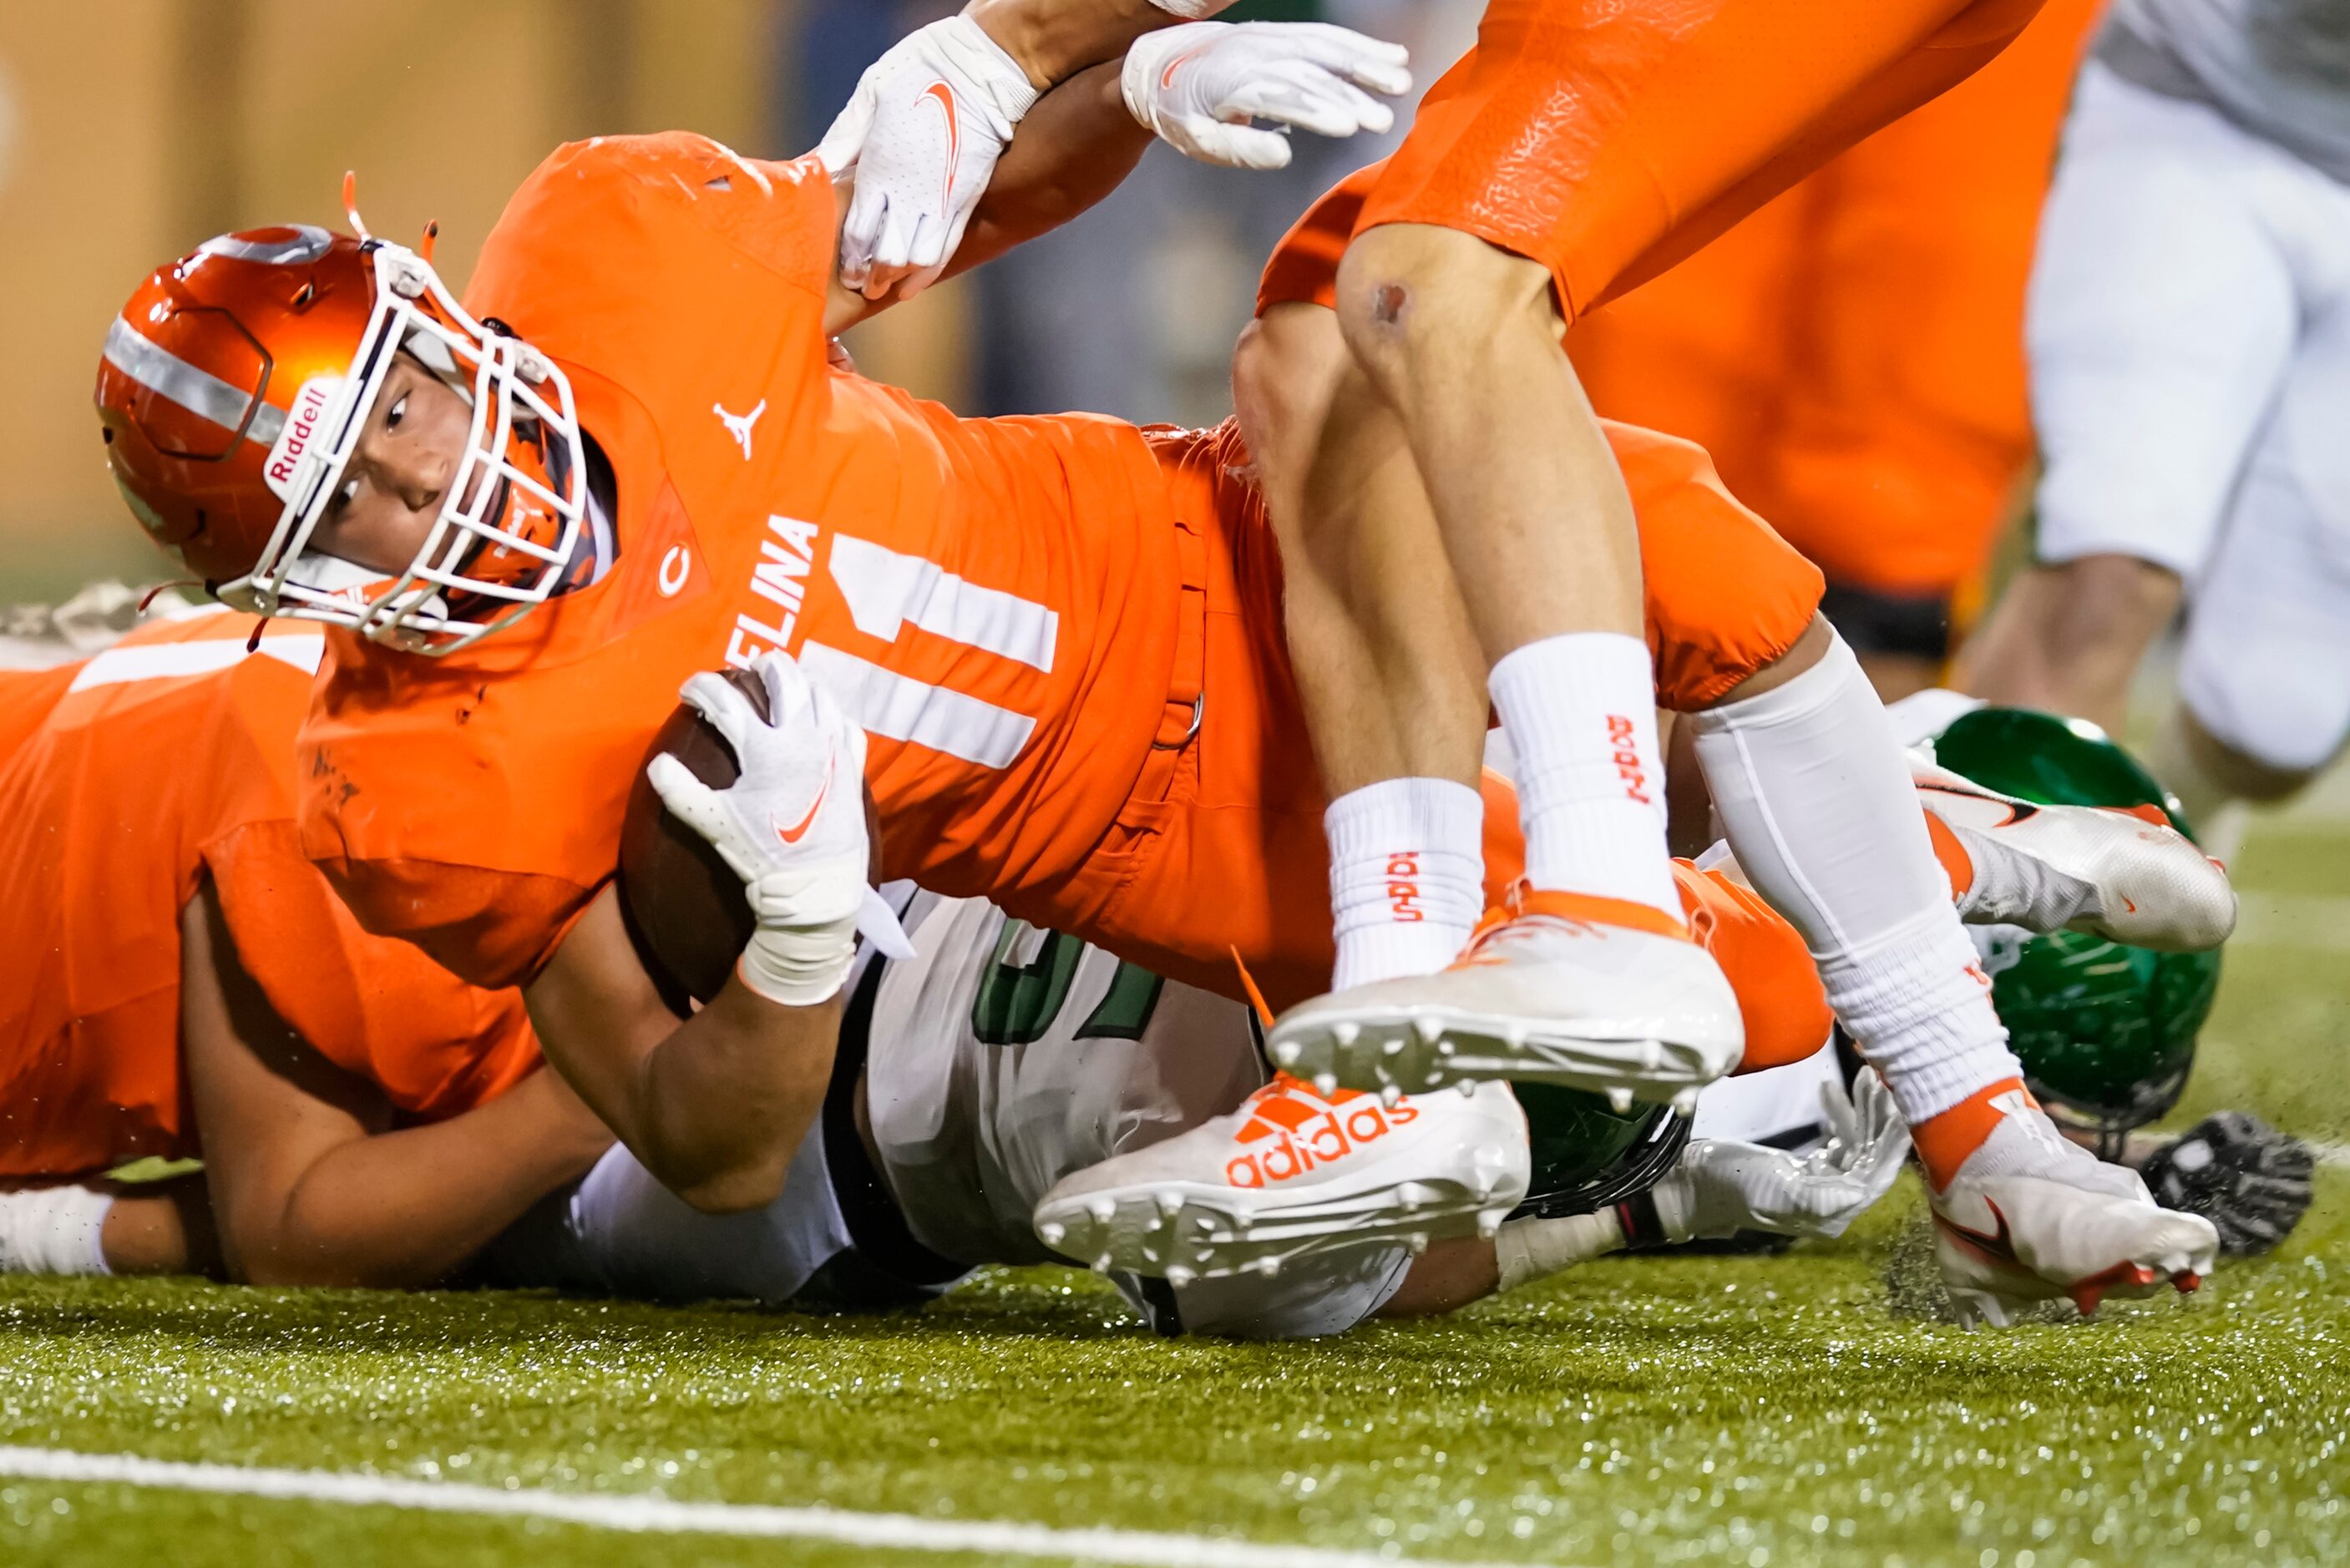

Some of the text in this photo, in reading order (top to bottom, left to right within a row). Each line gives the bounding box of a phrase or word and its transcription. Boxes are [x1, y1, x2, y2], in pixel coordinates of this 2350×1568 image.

[270, 387, 327, 483] Riddell
[658, 544, 691, 596] C
[724, 513, 819, 671] ELINA
[796, 532, 1059, 771] 11
[1226, 1095, 1419, 1190] adidas
